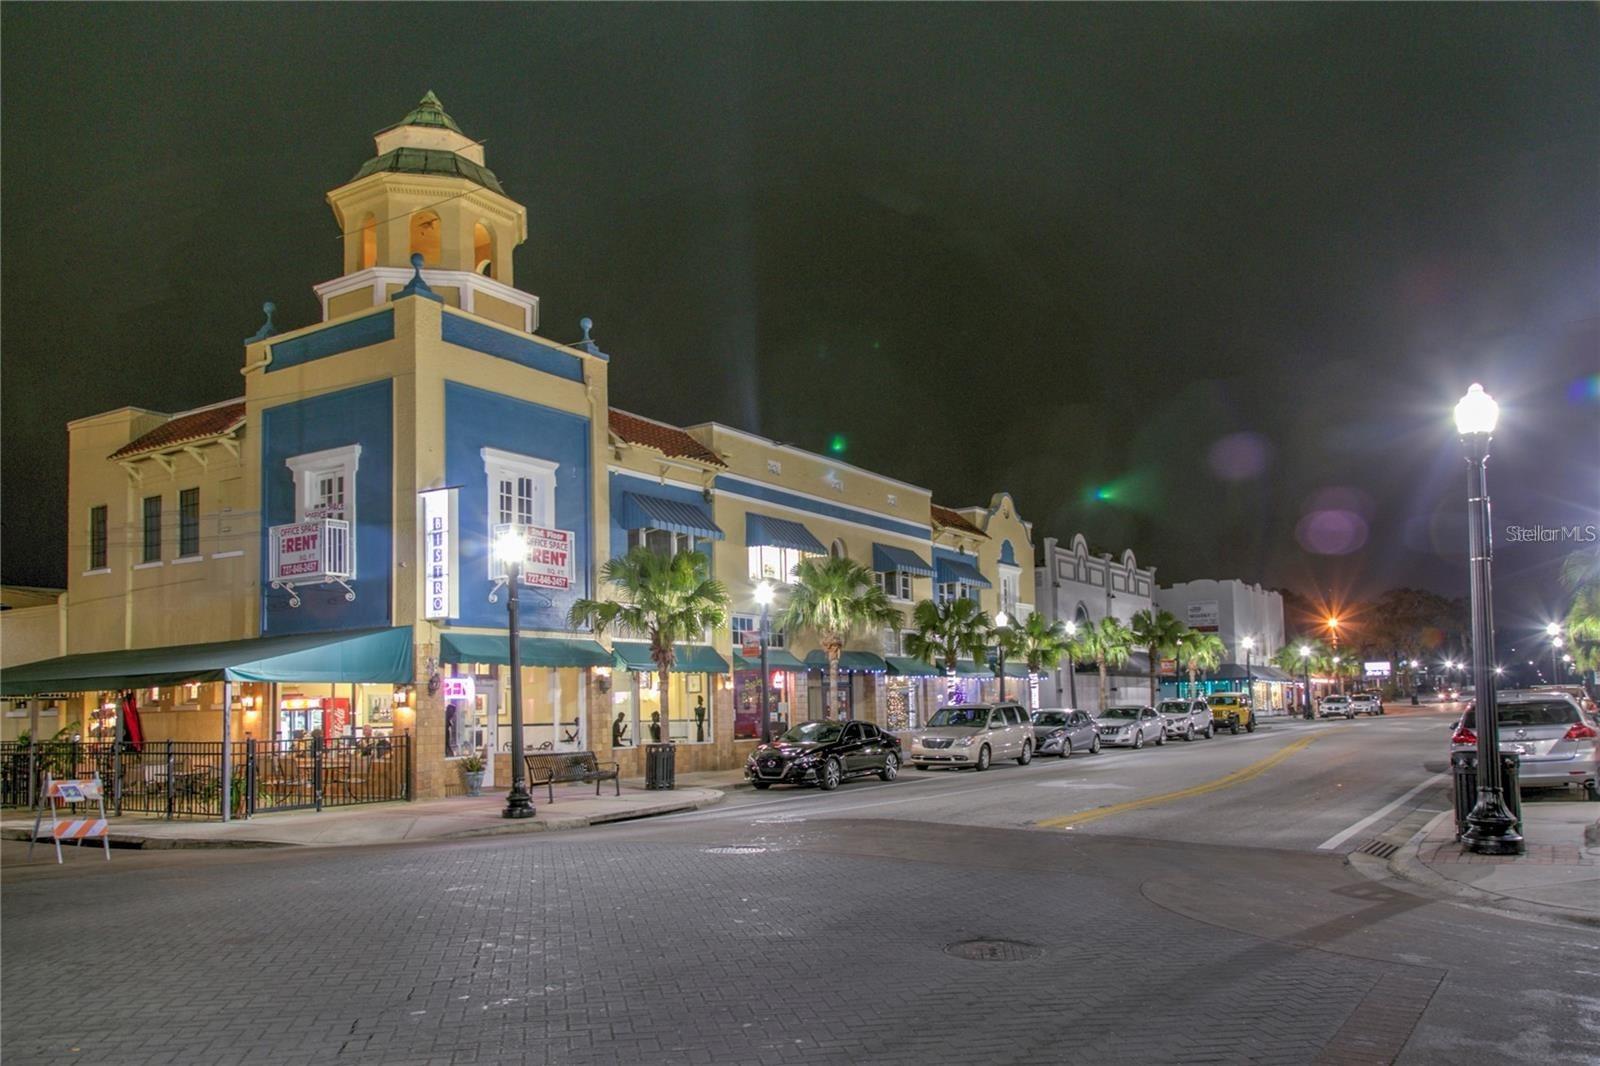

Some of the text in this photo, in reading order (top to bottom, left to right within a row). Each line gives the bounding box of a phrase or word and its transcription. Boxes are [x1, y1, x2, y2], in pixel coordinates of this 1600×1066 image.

[281, 524, 318, 537] OFFICE SPACE
[286, 534, 318, 553] RENT
[549, 541, 568, 552] SPACE
[433, 517, 442, 610] BISTRO
[532, 548, 567, 567] RENT
